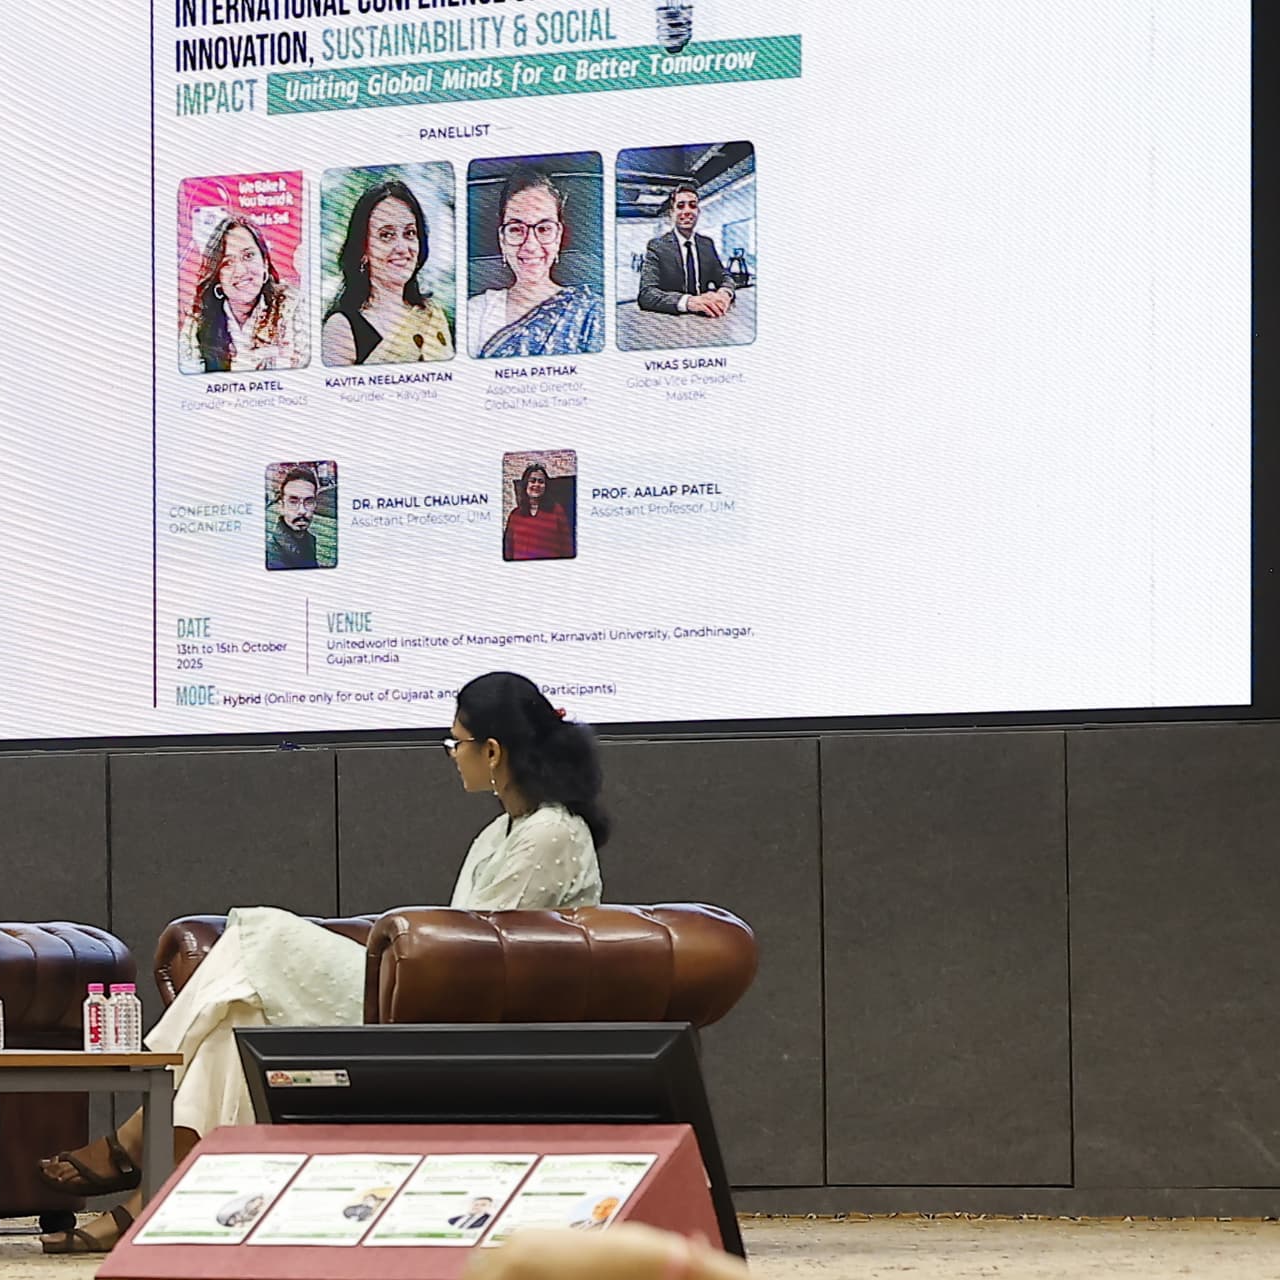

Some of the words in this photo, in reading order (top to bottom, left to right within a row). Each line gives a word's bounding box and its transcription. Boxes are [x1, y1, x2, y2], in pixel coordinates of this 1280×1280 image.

[175, 31, 314, 72] INNOVATION,
[322, 16, 505, 61] SUSTAINABILITY
[513, 14, 527, 47] &
[536, 8, 617, 45] SOCIAL
[285, 75, 359, 103] Uniting
[368, 70, 432, 96] Global
[442, 64, 502, 91] Minds
[512, 61, 541, 91] for
[553, 65, 567, 83] a
[576, 58, 639, 81] Better
[650, 51, 757, 76] Tomorrow
[176, 79, 258, 116] IMPACT
[419, 124, 490, 139] PANELLIST
[495, 368, 527, 379] NEHA
[531, 365, 578, 377] PATHAK
[644, 360, 678, 371] VIKAS
[682, 358, 727, 369] SURANI
[206, 382, 246, 394] ARPITA
[249, 380, 284, 392] PATEL
[325, 376, 365, 388] KAVITA
[369, 372, 452, 385] NEELAKANTAN
[592, 487, 630, 499] PROF.
[633, 485, 678, 498] AALAP
[682, 483, 722, 496] PATEL
[169, 502, 253, 518] CONFERENCE
[352, 498, 373, 511] DR.
[377, 496, 419, 509] RAHUL
[423, 494, 488, 507] CHAUHAN
[590, 504, 644, 518] Assistant
[169, 520, 242, 535] ORGANIZER
[351, 514, 404, 528] Assistant
[177, 617, 211, 638] DATE
[327, 612, 373, 633] VENUE
[327, 638, 398, 651] Unitedworld
[401, 636, 449, 648] Institute
[452, 635, 464, 646] of
[466, 631, 548, 648] Management,
[550, 630, 607, 643] Karnavati
[609, 628, 671, 642] University,
[673, 626, 755, 639] Gandhinagar,
[177, 644, 199, 655] 13th
[202, 644, 214, 654] to
[216, 642, 239, 654] 15th
[242, 641, 288, 654] October
[176, 658, 203, 670] 2025
[176, 685, 219, 706] MODE:
[223, 692, 262, 707] Hybrid
[264, 692, 306, 705] (Online
[309, 692, 333, 705] only
[336, 691, 353, 703] for
[356, 691, 375, 702] out
[378, 690, 390, 702] of
[392, 688, 434, 703] Gujarat
[542, 684, 617, 697] Participants)
